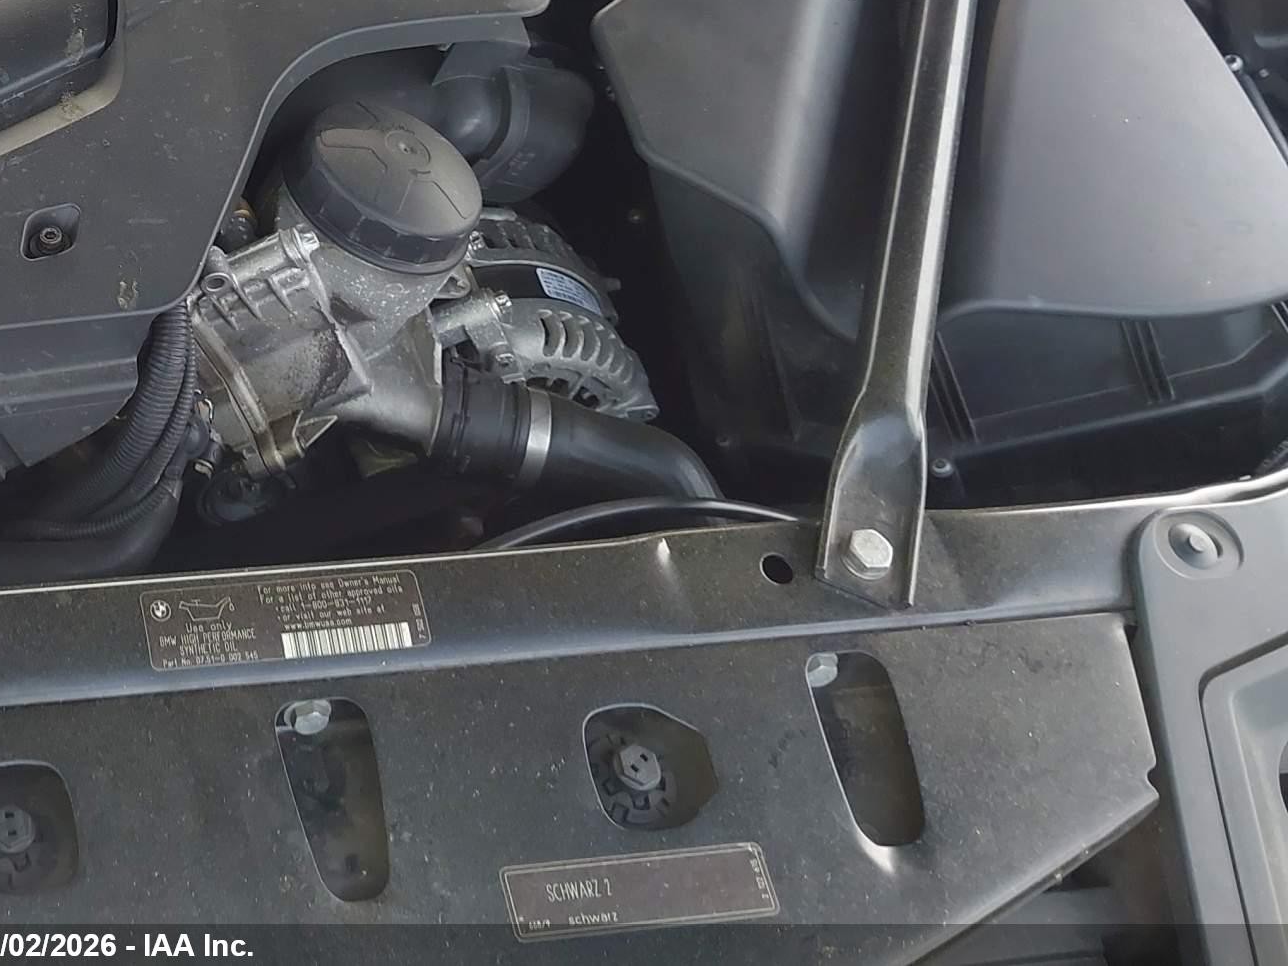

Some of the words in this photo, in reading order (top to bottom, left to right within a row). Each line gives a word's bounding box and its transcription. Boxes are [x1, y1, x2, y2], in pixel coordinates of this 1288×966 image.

[372, 573, 400, 585] Manual
[321, 590, 342, 599] other
[347, 585, 383, 598] approved
[336, 606, 352, 616] web
[185, 622, 204, 633] Use
[210, 620, 232, 631] only
[284, 618, 352, 630] www.bmwusa.com
[159, 635, 177, 647] BMW
[180, 633, 199, 645] HIGH
[203, 628, 257, 643] PERFORMANCE
[179, 642, 221, 656] SYNTHETIC
[224, 641, 238, 652] OIL
[546, 878, 602, 903] SCHWARZ
[604, 878, 612, 896] 2
[568, 911, 618, 925] schwarz
